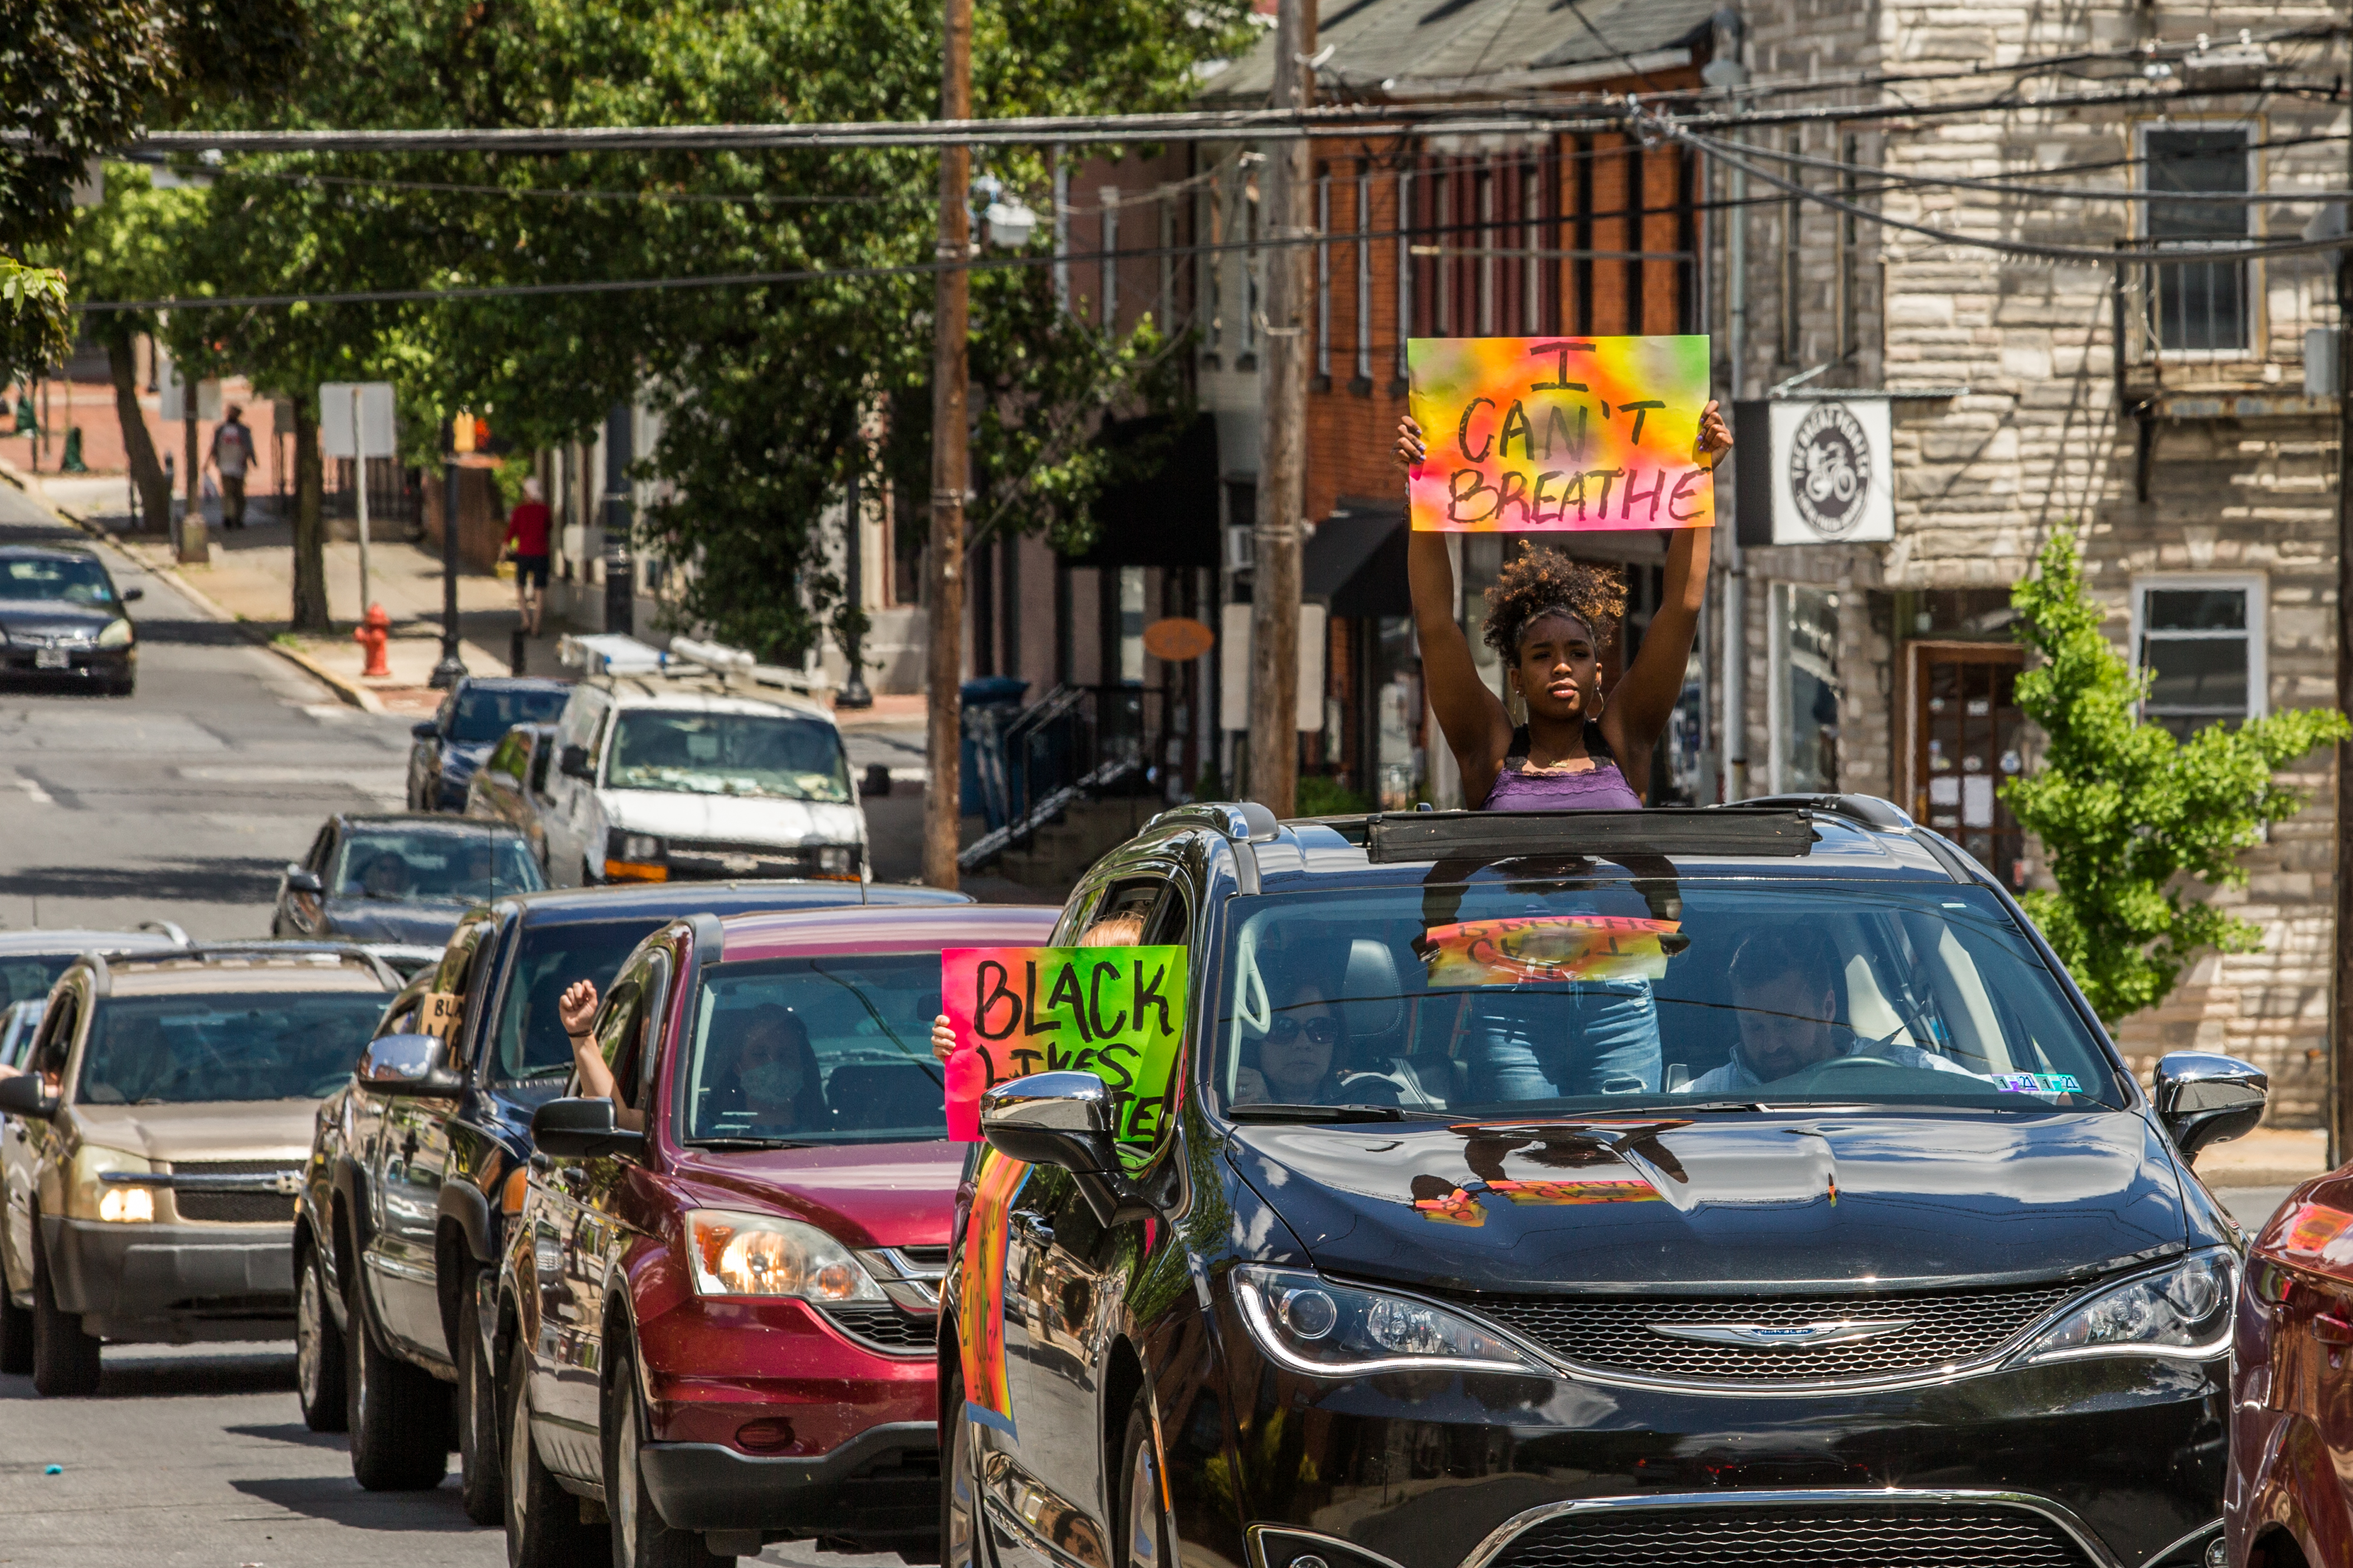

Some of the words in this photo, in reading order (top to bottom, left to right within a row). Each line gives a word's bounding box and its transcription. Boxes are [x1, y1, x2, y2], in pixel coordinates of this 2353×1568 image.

[1530, 341, 1596, 392] I
[1458, 397, 1665, 463] CAN'T
[1447, 467, 1712, 524] BREATHE
[973, 960, 1175, 1043] BLACK
